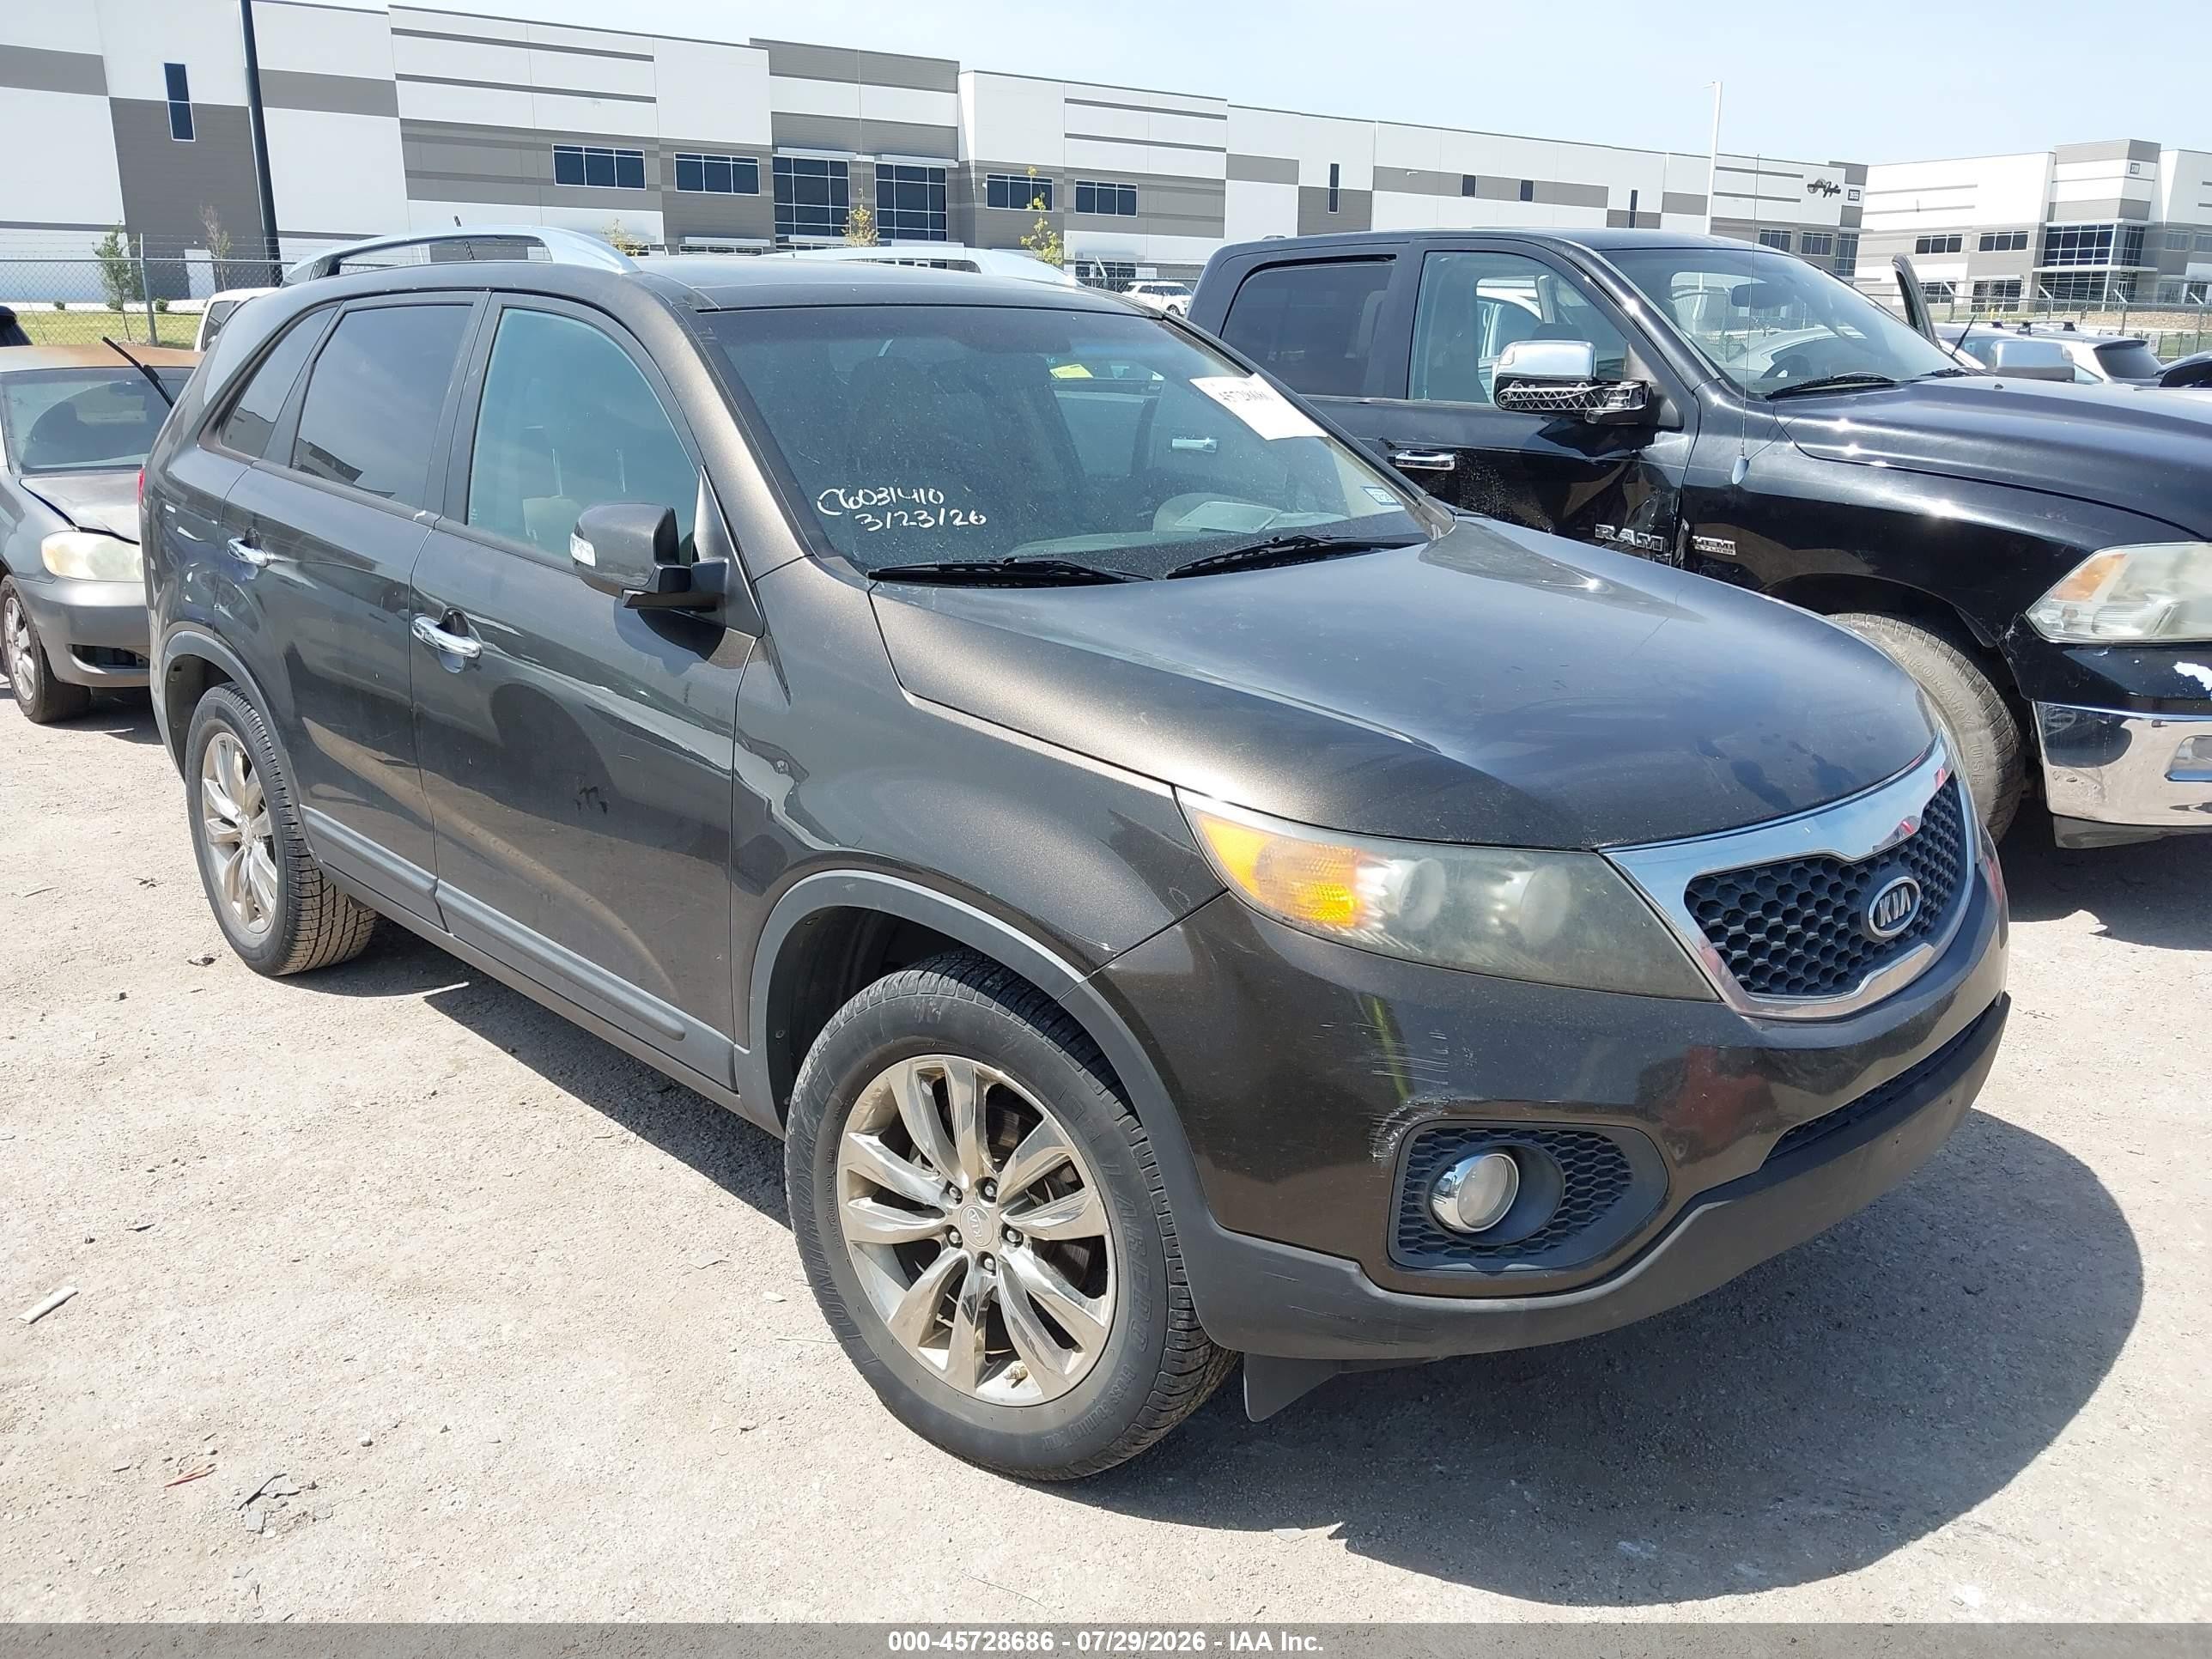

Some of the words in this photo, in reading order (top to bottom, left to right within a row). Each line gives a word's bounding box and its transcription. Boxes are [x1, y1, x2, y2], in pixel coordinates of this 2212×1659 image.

[1595, 523, 1665, 552] RAM
[1692, 536, 1736, 550] HEMI
[1878, 885, 1911, 927] KIA
